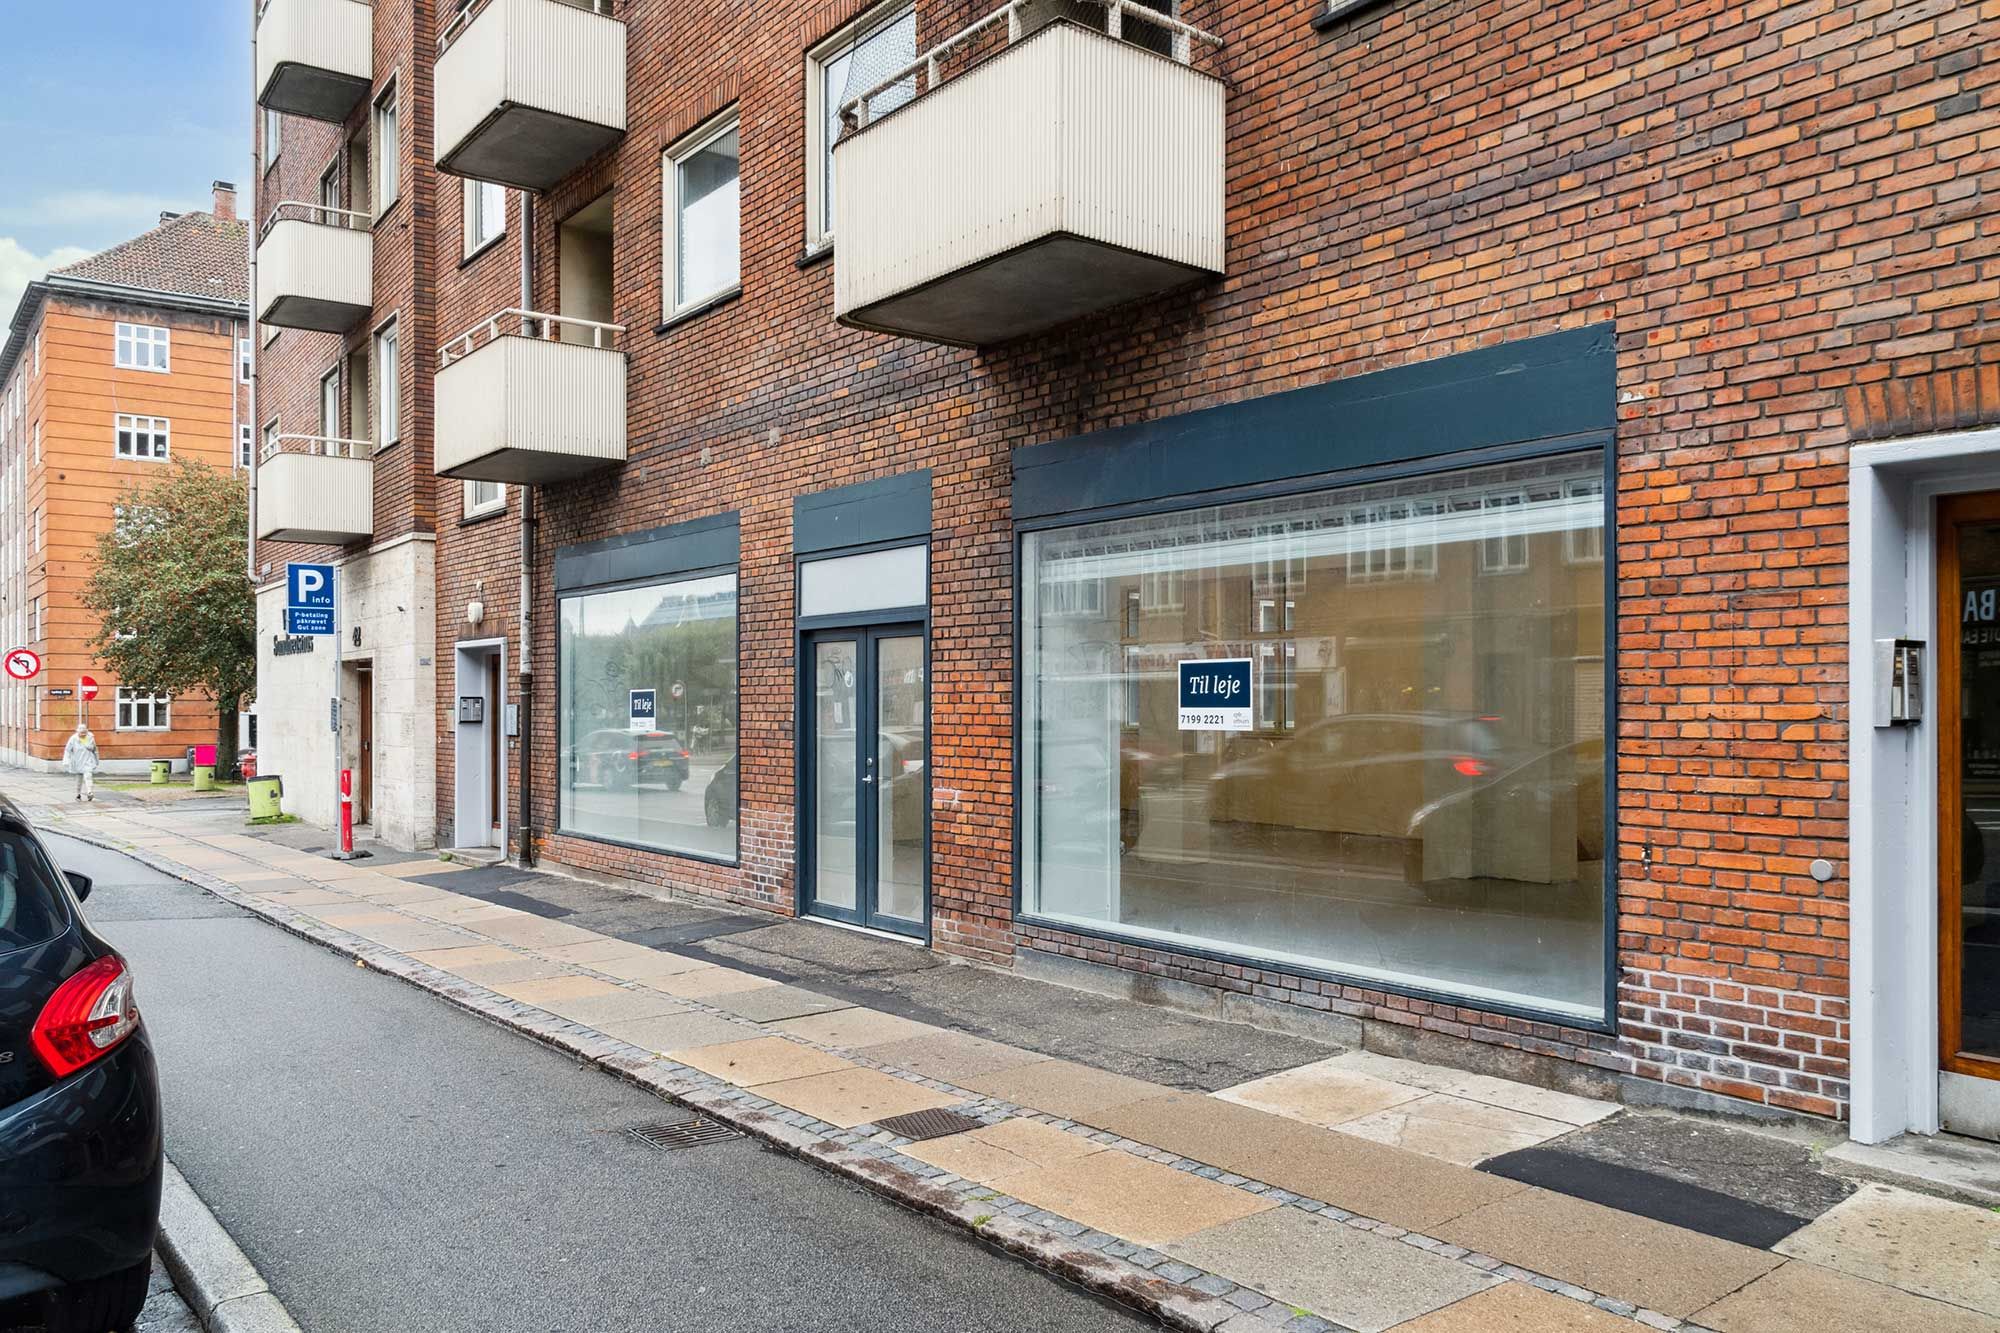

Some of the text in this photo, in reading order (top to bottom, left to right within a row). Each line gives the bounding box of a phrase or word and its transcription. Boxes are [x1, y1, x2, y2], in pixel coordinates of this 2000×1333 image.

[298, 569, 324, 603] P
[312, 596, 331, 604] info
[1189, 674, 1240, 699] Til leje
[1181, 715, 1201, 724] 7199
[1203, 714, 1224, 724] 2221
